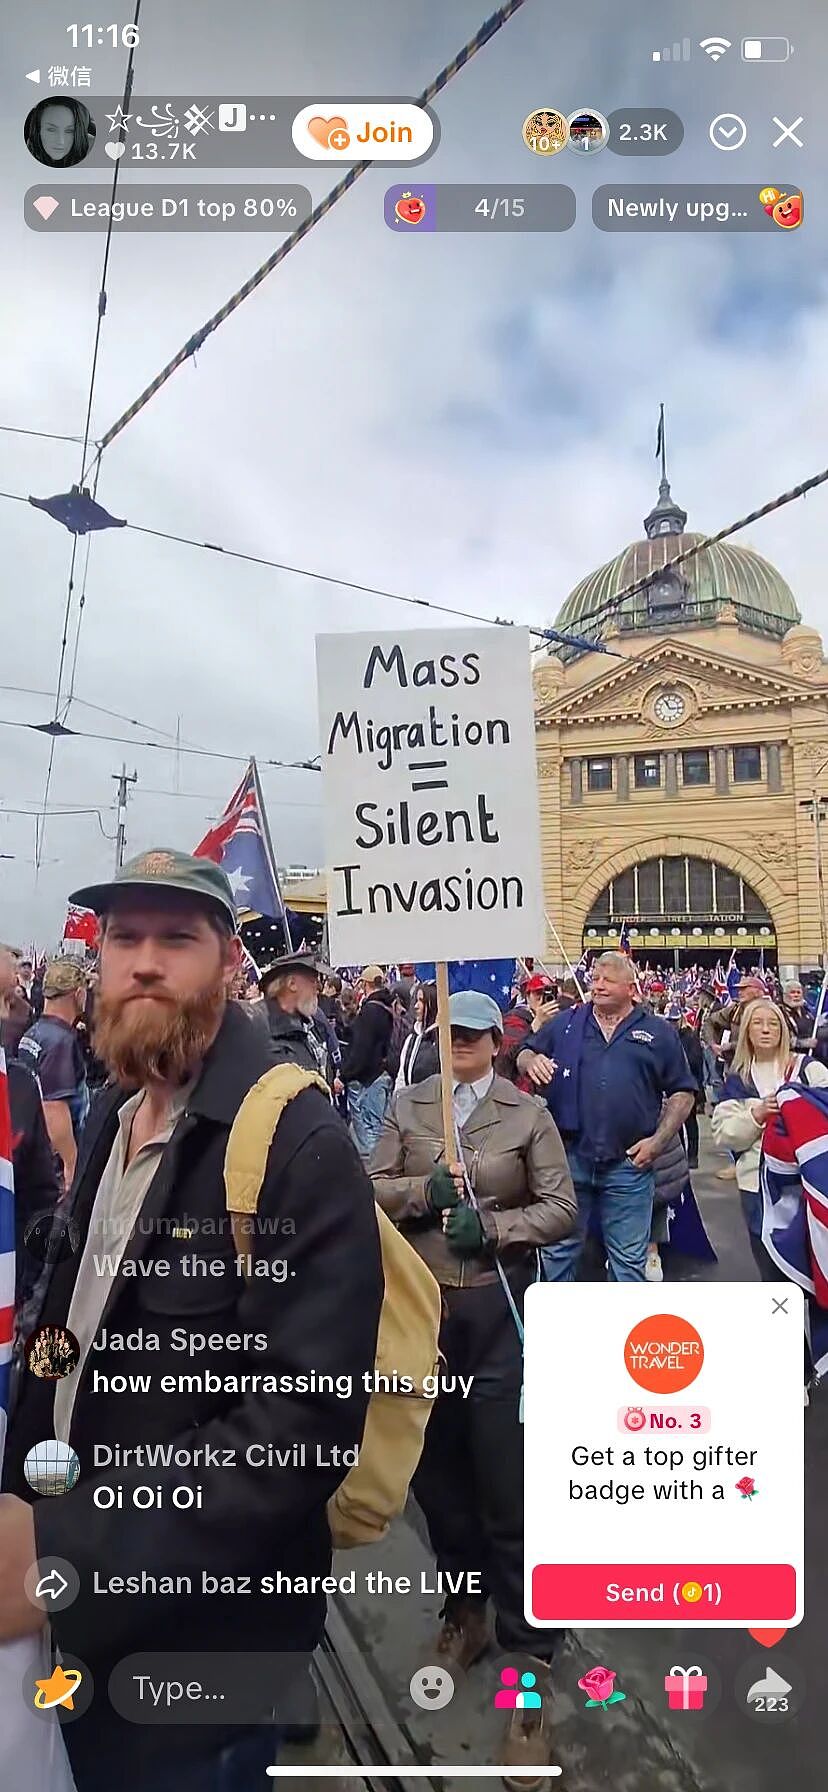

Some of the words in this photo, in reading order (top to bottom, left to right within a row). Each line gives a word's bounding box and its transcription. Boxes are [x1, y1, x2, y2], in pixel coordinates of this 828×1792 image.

[363, 645, 480, 689] Mass
[327, 706, 510, 771] Migration
[355, 793, 500, 849] Silent
[333, 865, 523, 917] Invasion
